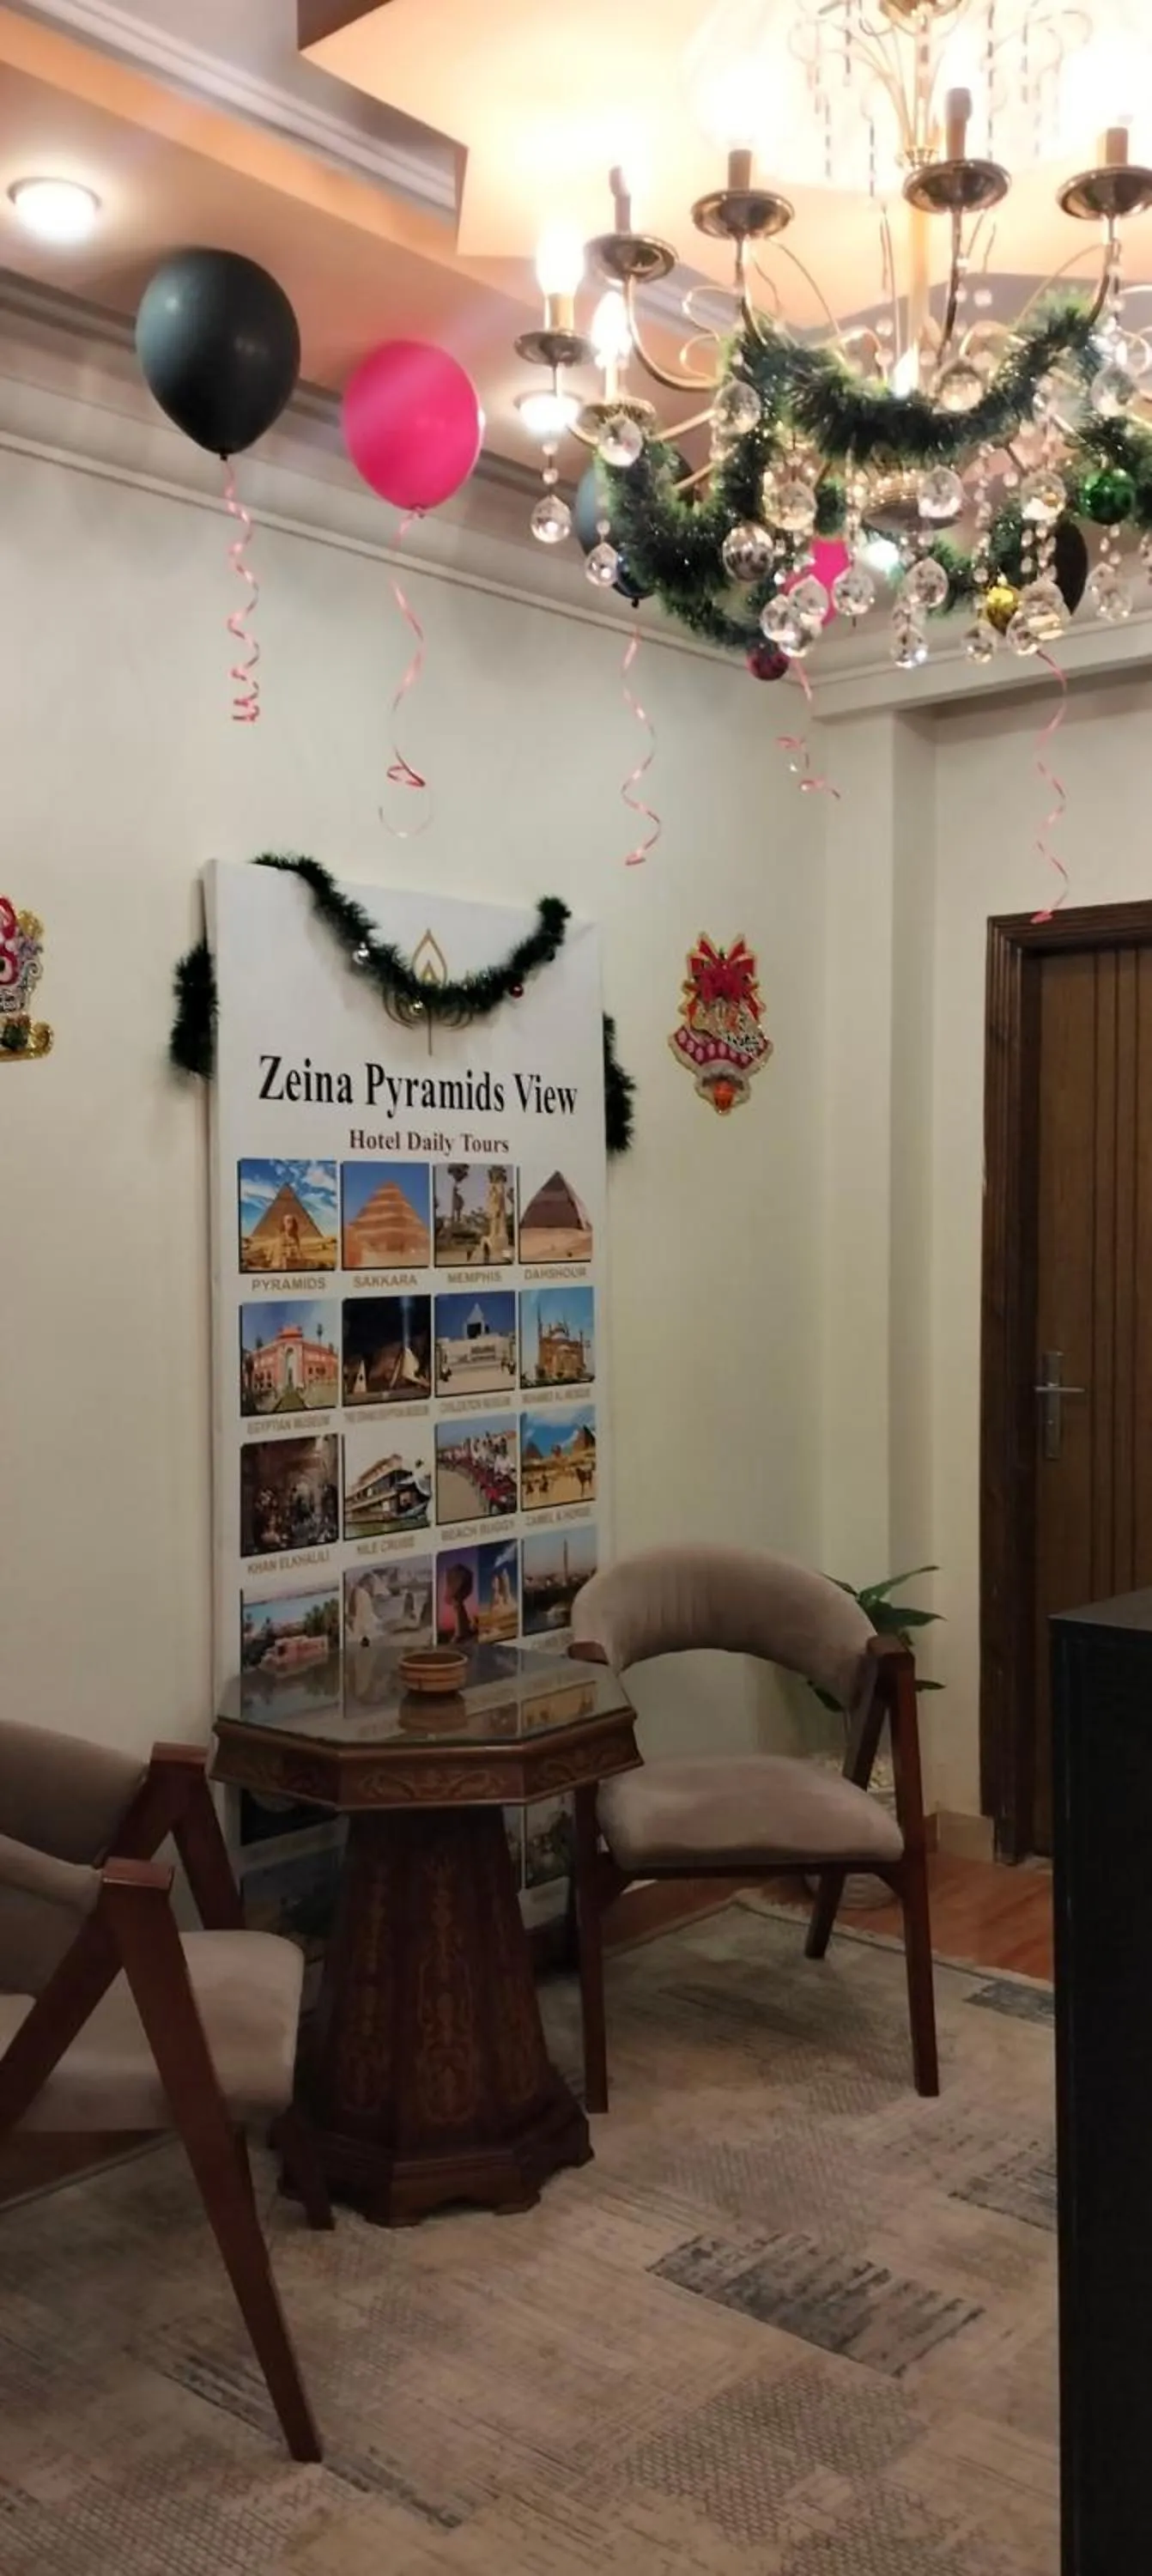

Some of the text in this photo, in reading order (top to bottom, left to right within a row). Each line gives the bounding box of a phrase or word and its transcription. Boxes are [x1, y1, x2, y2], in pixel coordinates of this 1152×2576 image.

[259, 1054, 578, 1119] Zeina Pyramids View
[349, 1129, 510, 1156] Hotel Daily Tours
[353, 1273, 417, 1288] SAKKARA
[447, 1270, 502, 1284] MEMPHIS
[524, 1267, 586, 1280] DAHSHOUR
[252, 1277, 326, 1291] PYRAMIDS
